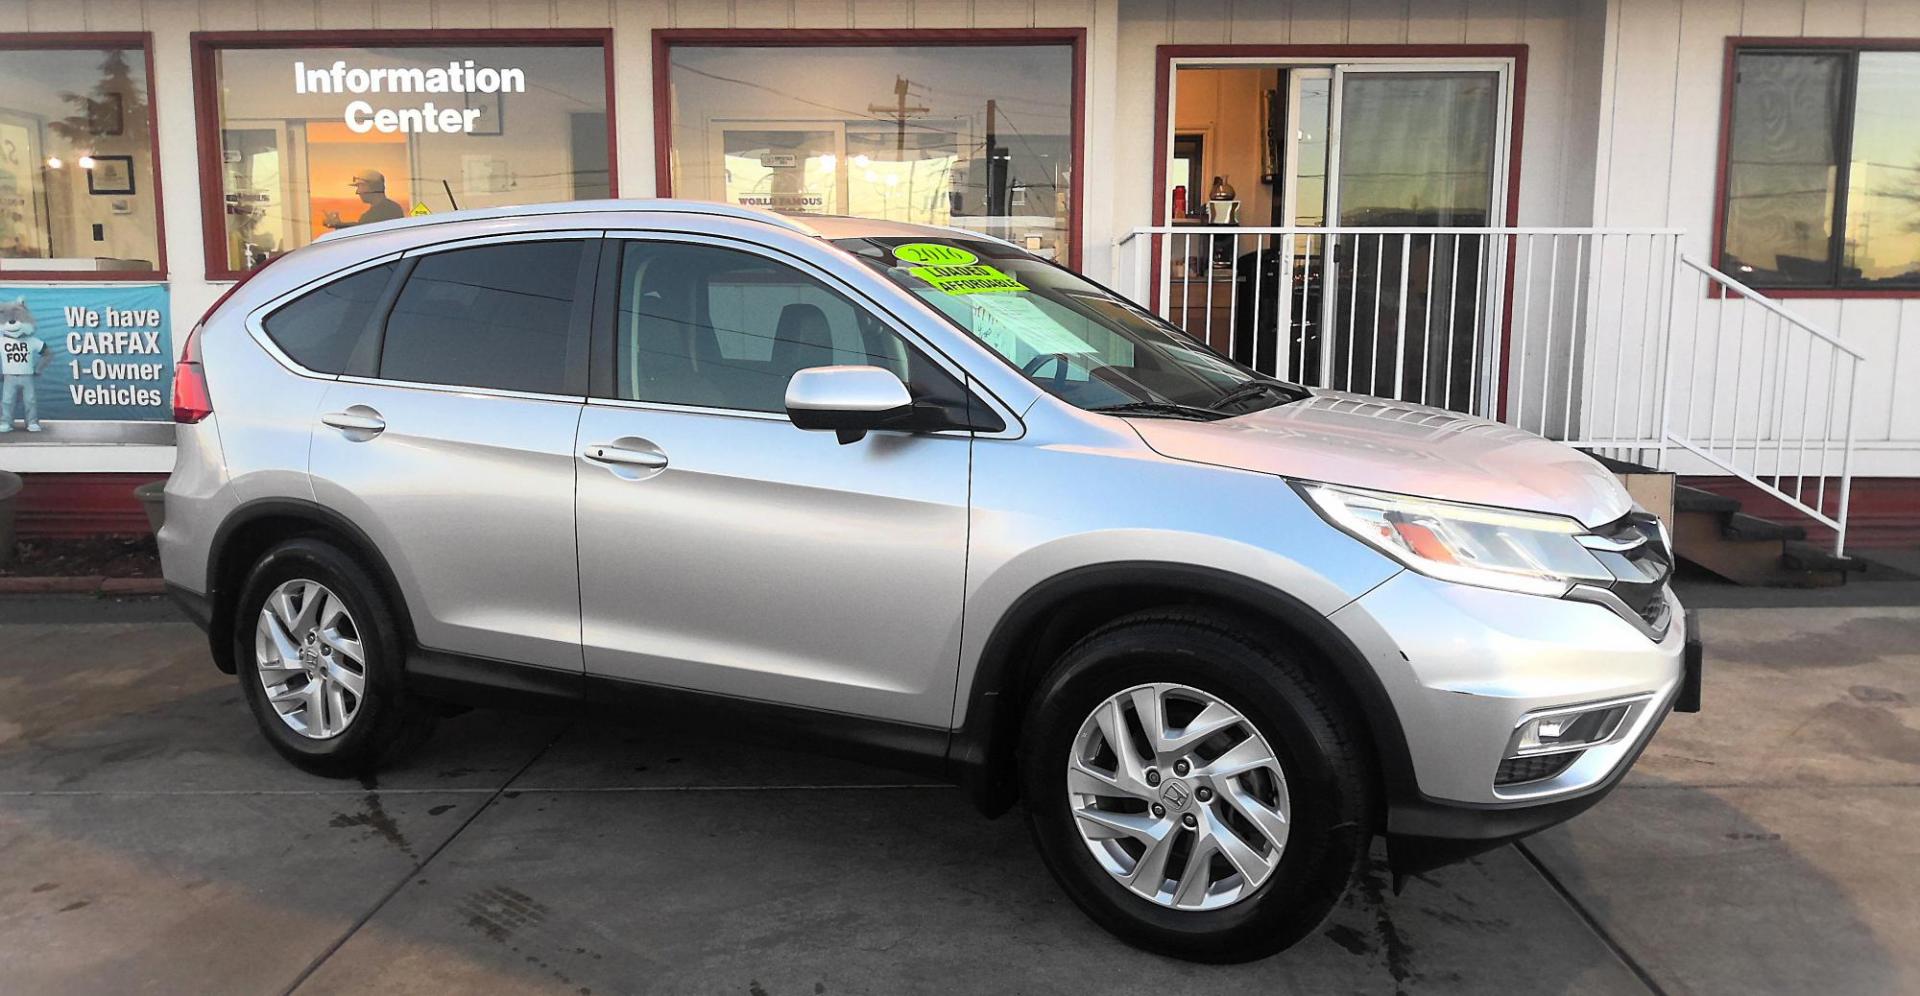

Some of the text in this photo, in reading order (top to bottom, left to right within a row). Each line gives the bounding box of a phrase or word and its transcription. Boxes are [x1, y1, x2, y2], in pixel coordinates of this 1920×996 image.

[294, 60, 525, 94] Information
[344, 100, 481, 133] Center
[907, 246, 963, 262] 2016
[923, 265, 991, 278] LOADED
[938, 278, 1021, 292] AFFORDABLE
[64, 306, 161, 328] We have
[4, 342, 28, 352] CAR
[66, 331, 161, 355] CARFAX
[6, 352, 29, 363] FOX
[68, 358, 162, 380] 1-Owner
[69, 384, 162, 406] Vehicles
